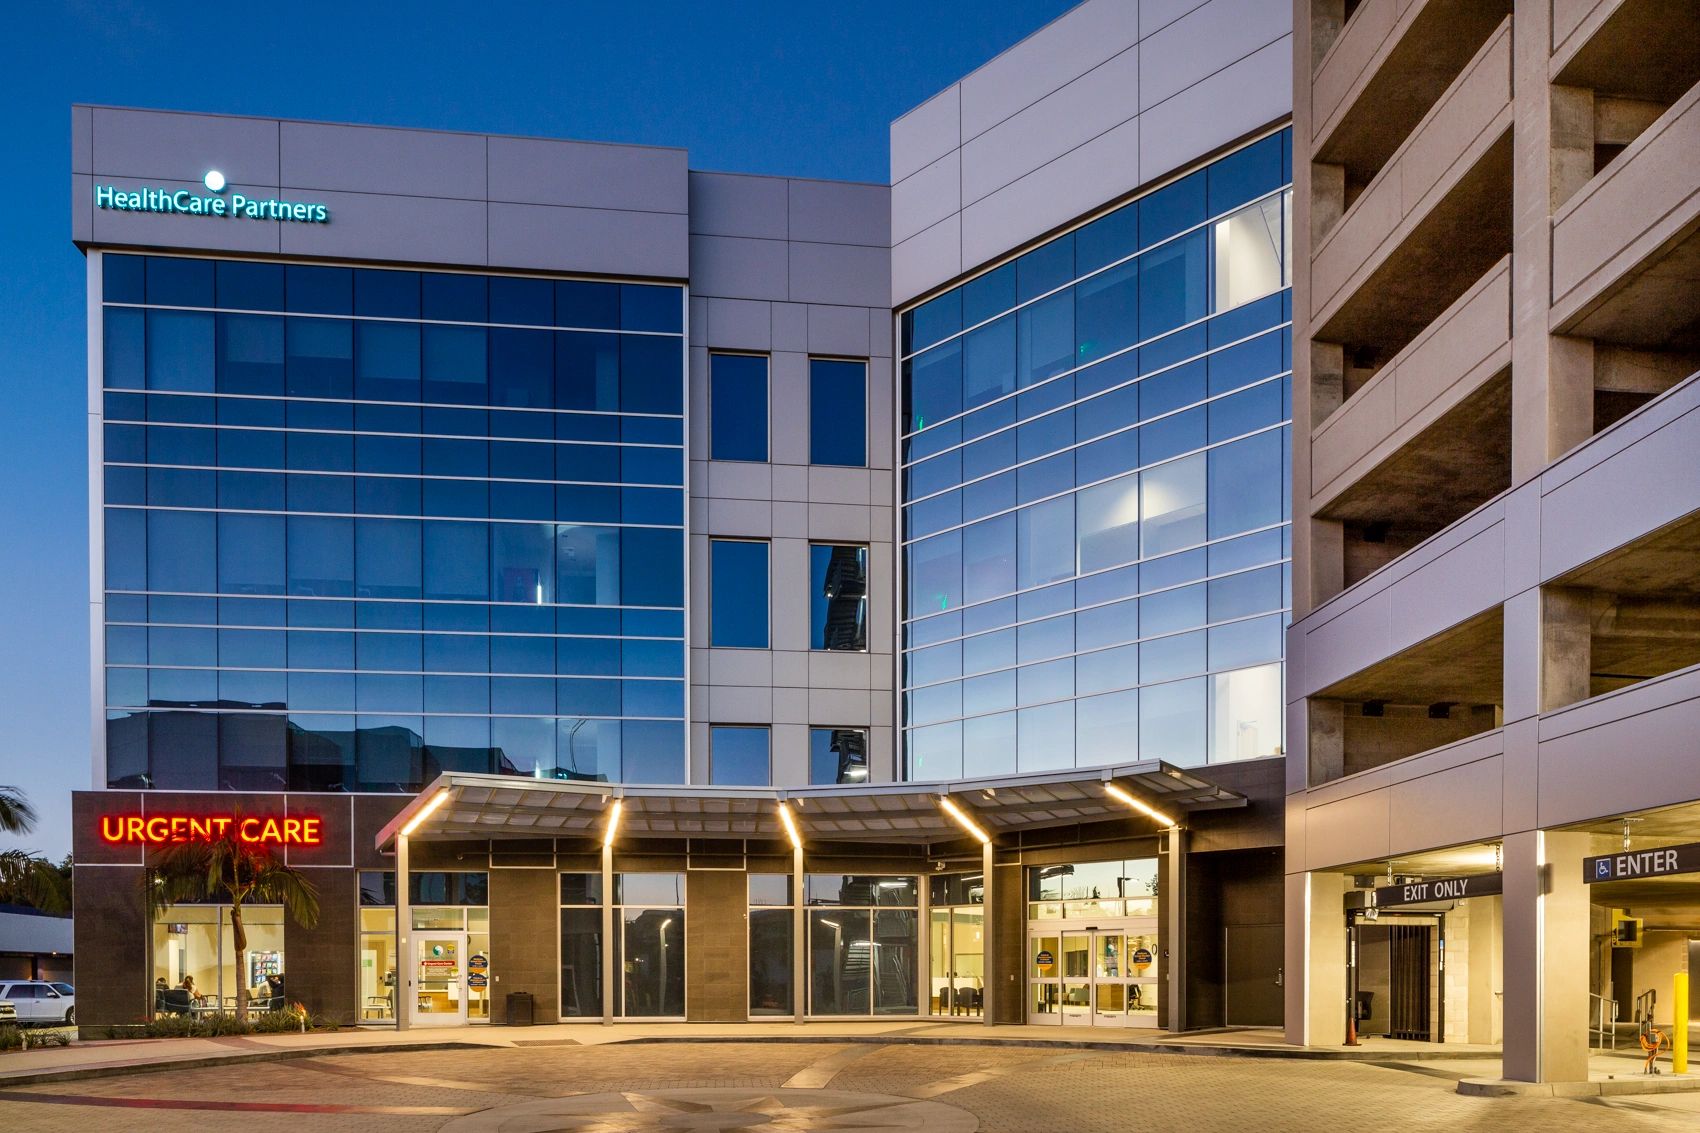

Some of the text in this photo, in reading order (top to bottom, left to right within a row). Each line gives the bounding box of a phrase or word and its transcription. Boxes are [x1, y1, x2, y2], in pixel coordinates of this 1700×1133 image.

[97, 186, 326, 220] HealthCare Partners
[103, 817, 320, 843] URGENT CARE
[1616, 849, 1678, 876] ENTER
[1403, 878, 1469, 901] EXIT ONLY
